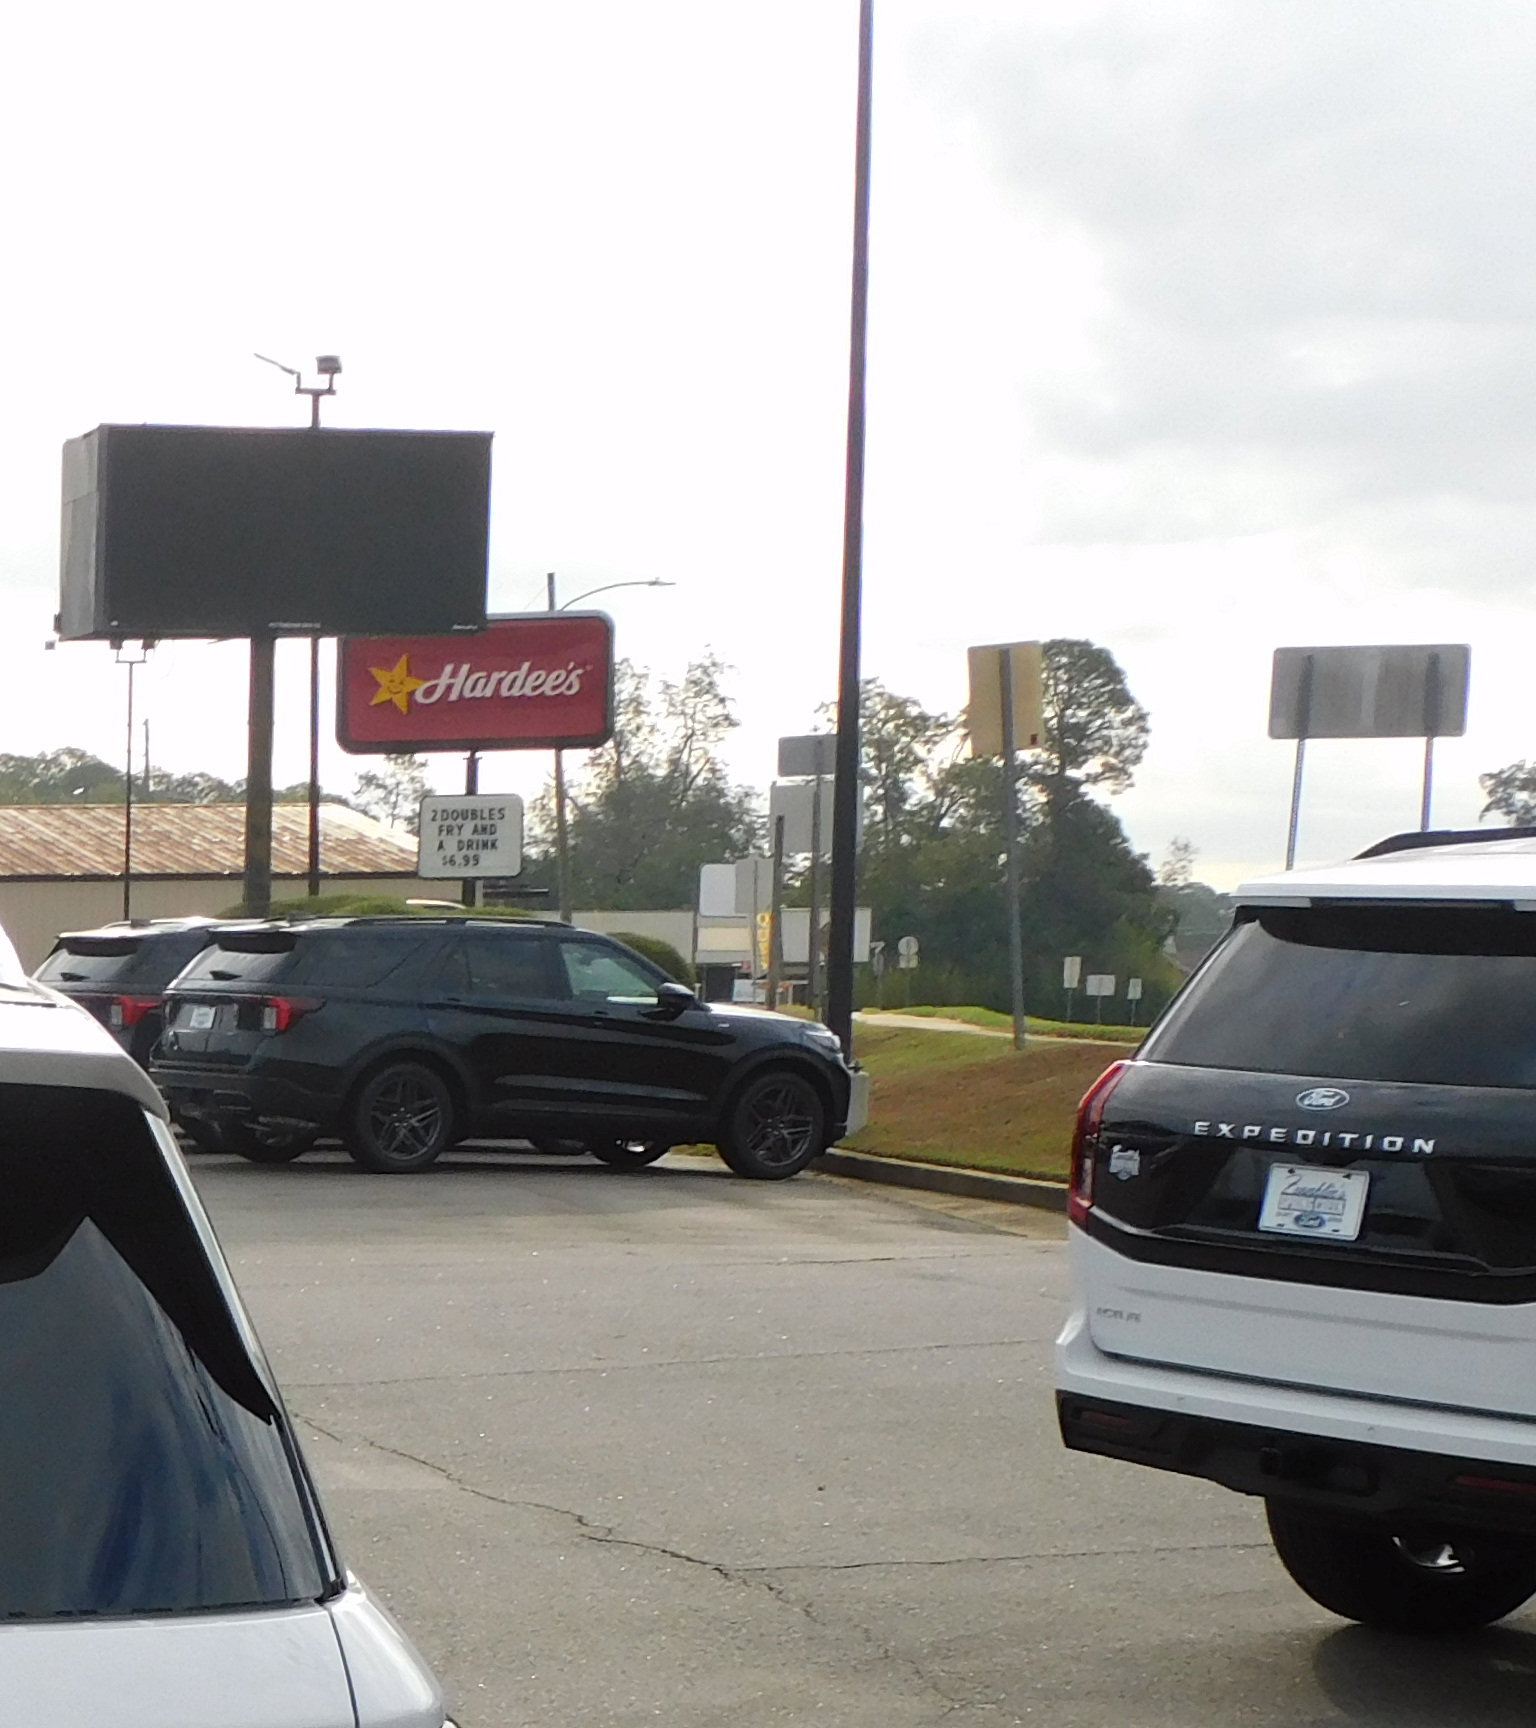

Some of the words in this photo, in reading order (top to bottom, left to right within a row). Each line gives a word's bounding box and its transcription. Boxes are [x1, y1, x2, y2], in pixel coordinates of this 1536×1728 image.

[414, 661, 586, 704] Hardee's
[438, 823, 464, 836] FRY
[471, 823, 497, 836] AND
[437, 839, 445, 852] A
[456, 838, 499, 851] DRINK
[1193, 1121, 1436, 1154] EXPEDITION
